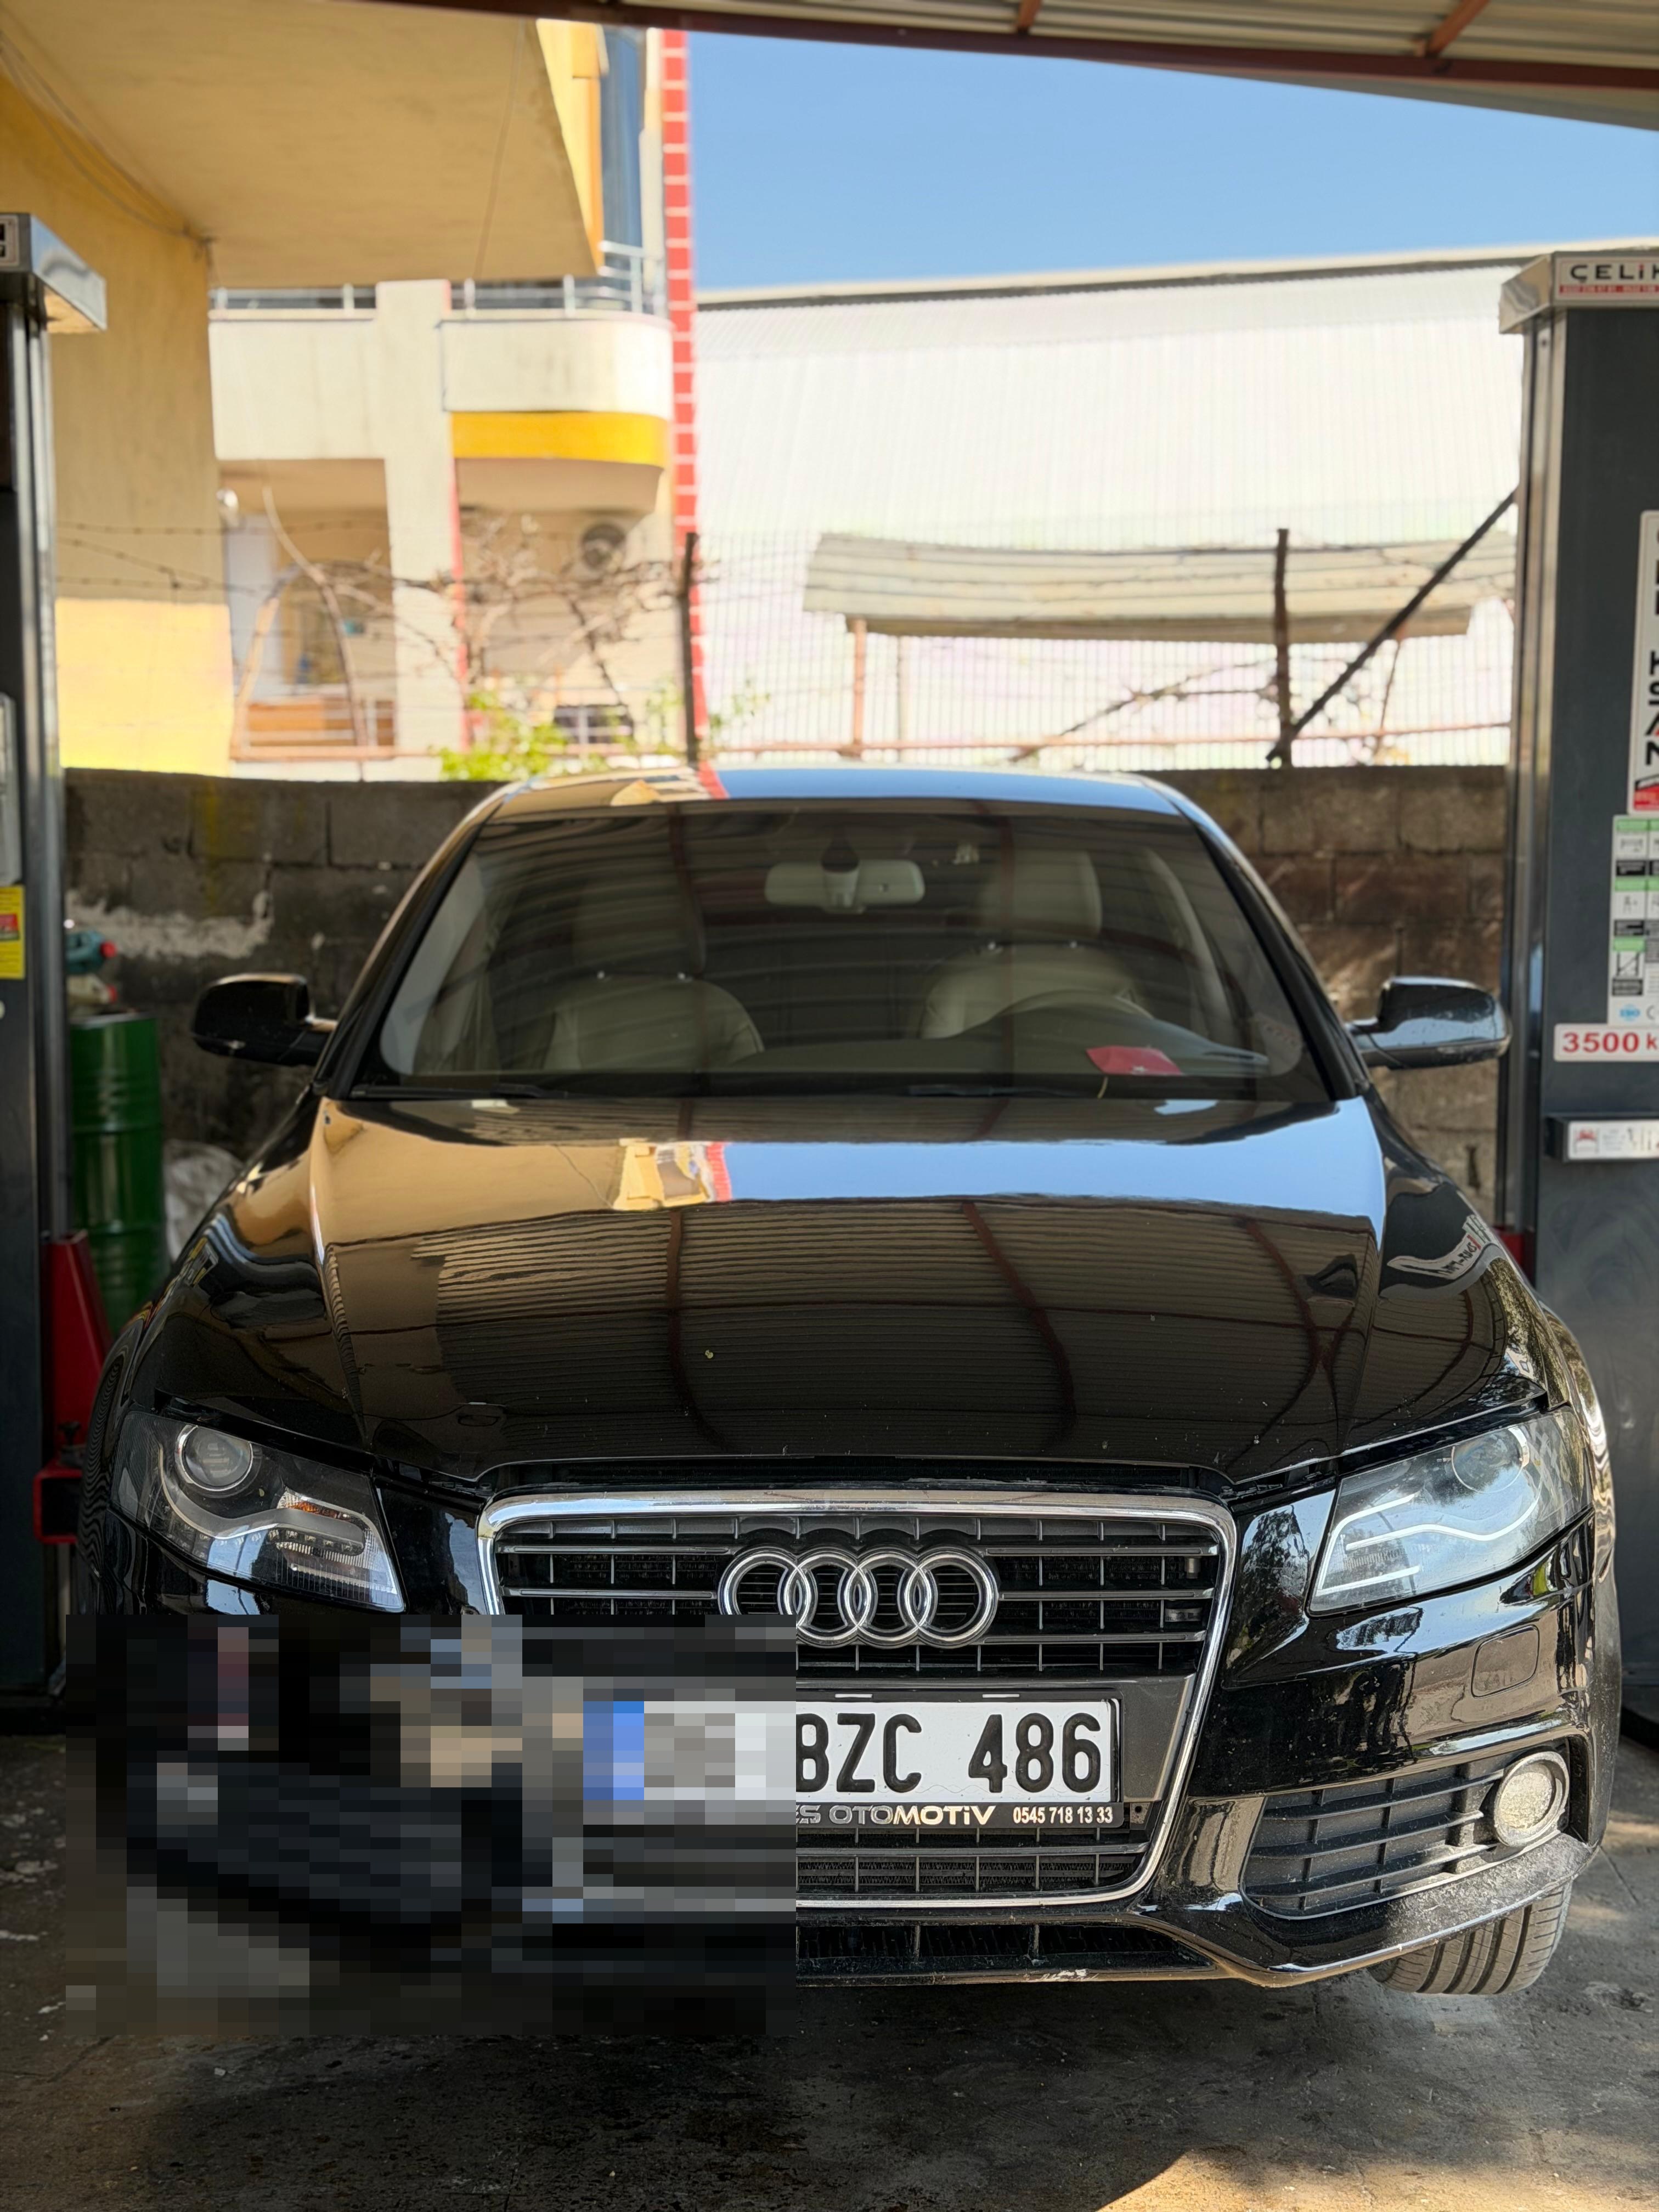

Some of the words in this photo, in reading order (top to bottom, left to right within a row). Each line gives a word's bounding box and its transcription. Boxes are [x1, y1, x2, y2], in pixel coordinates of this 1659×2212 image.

[1563, 1031, 1639, 1053] 3500
[796, 1712, 922, 1793] BZC
[969, 1712, 1102, 1793] 486
[1013, 1805, 1046, 1824] 0545
[1049, 1805, 1073, 1824] 718
[1077, 1805, 1093, 1824] 13
[1097, 1805, 1114, 1824] 33
